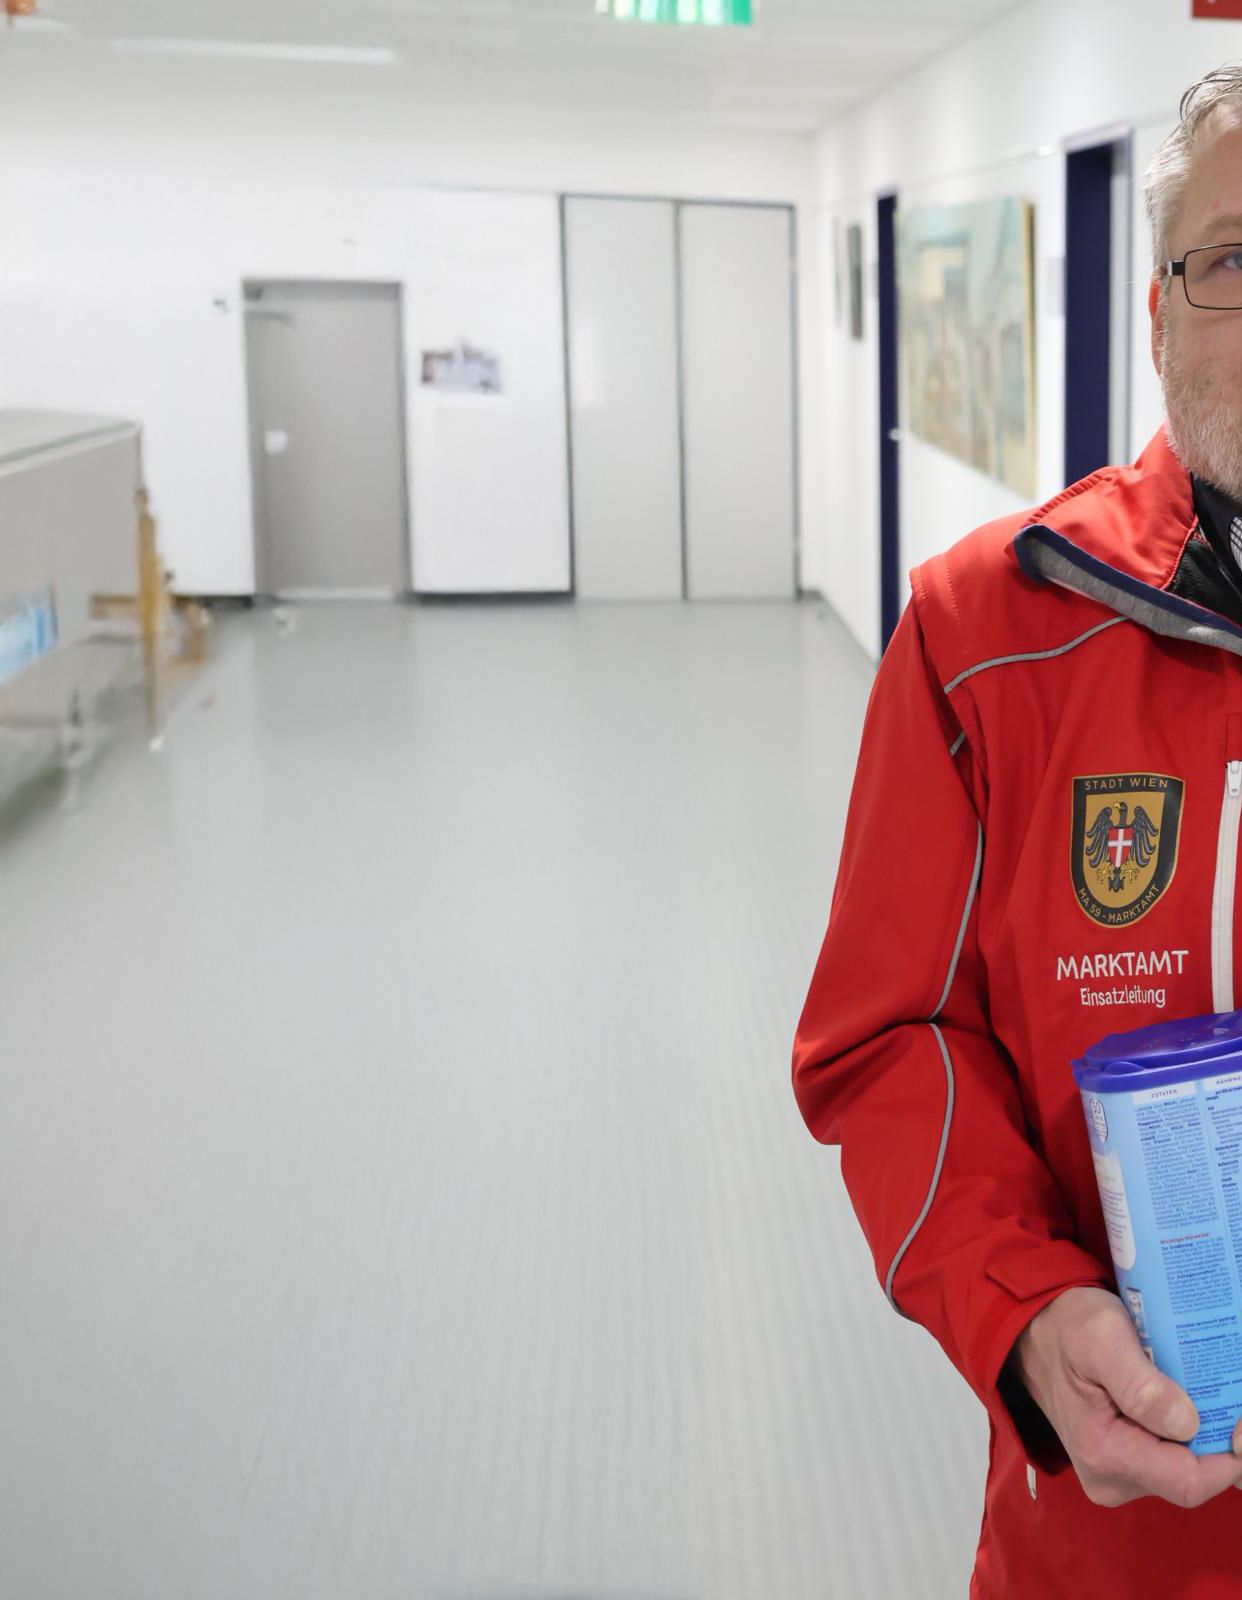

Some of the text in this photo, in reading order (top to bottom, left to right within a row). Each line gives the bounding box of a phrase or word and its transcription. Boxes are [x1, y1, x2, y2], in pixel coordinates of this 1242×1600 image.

[1085, 777, 1169, 791] STADT WIEN
[1078, 887, 1089, 907] MA
[1089, 905, 1101, 918] 59
[1108, 883, 1160, 923] MARKTAMT
[1056, 950, 1189, 981] MARKTAMT
[1080, 985, 1166, 1008] Einsatzleitung
